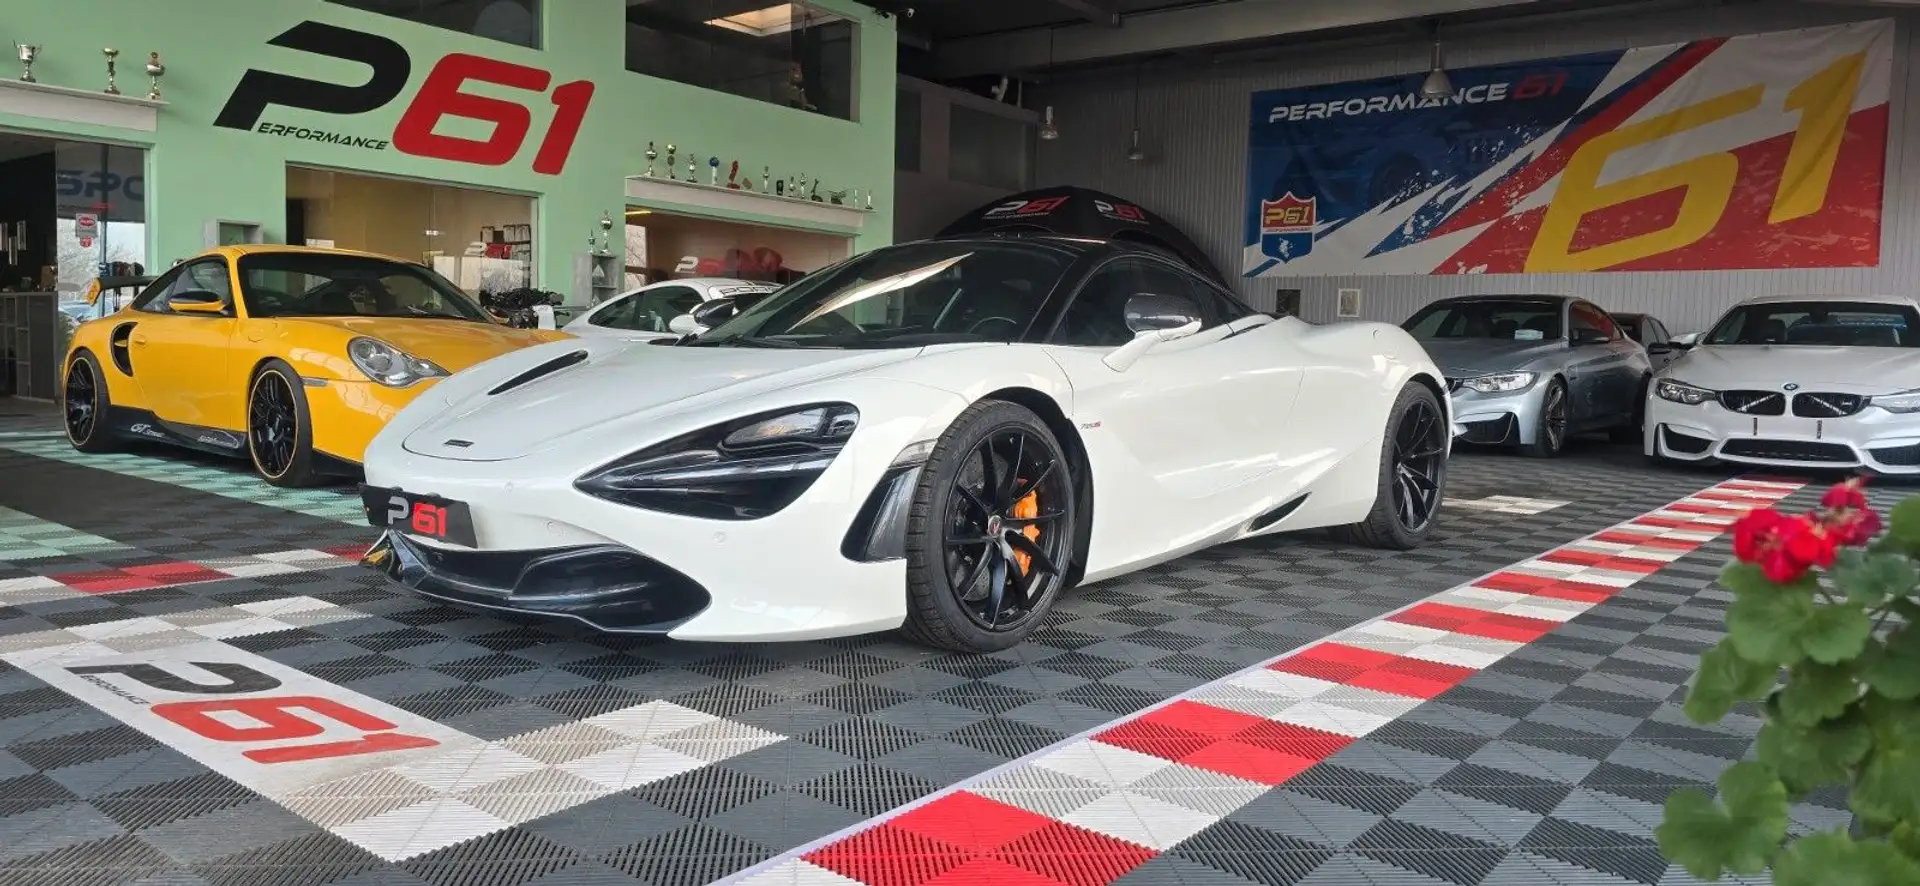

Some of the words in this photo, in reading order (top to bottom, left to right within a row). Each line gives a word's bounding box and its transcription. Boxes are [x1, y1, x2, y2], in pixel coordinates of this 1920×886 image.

[1512, 70, 1571, 99] 61
[1523, 49, 1867, 274] 61
[1265, 206, 1312, 226] P61
